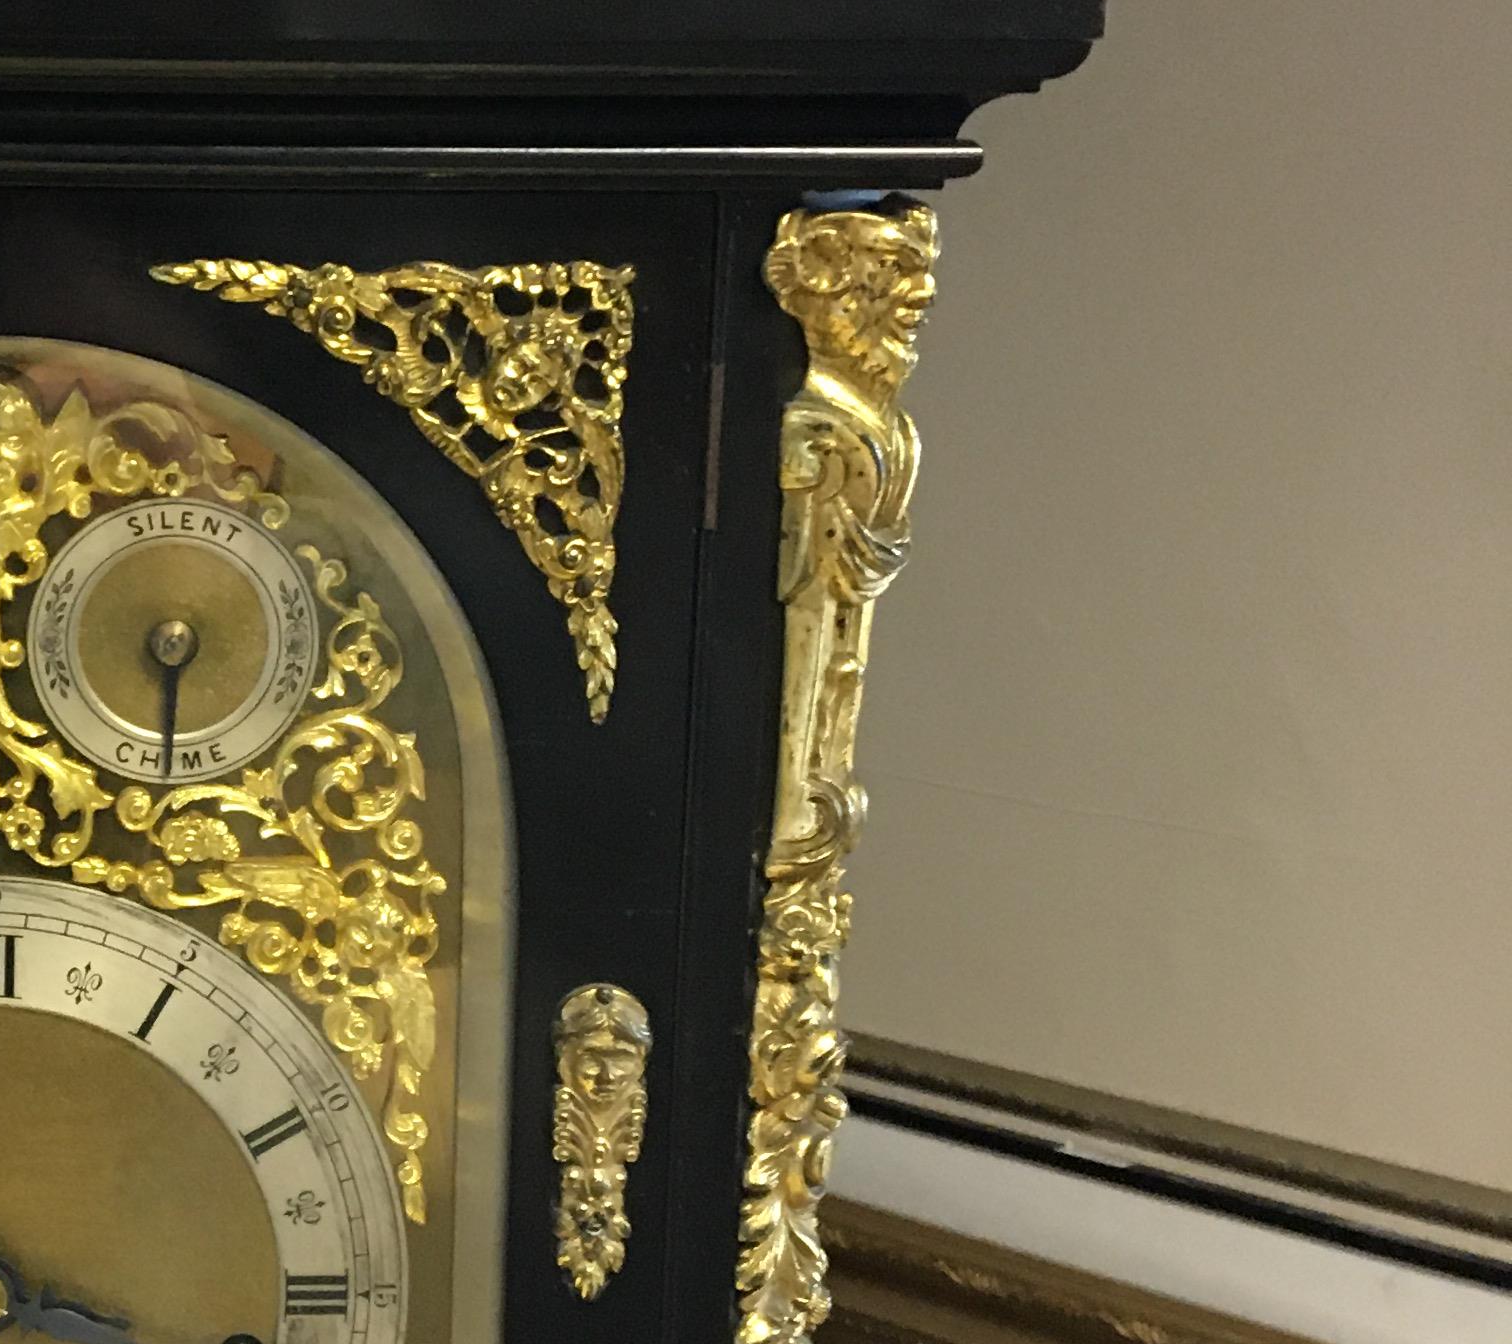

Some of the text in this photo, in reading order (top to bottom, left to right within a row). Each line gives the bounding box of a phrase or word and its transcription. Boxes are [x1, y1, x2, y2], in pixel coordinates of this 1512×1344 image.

[127, 512, 243, 543] SILENT
[116, 742, 226, 770] CHME
[180, 941, 202, 962] 5
[128, 977, 183, 1046] I
[320, 1081, 350, 1113] 10
[239, 1099, 311, 1164] II
[285, 1268, 349, 1322] III
[374, 1282, 398, 1309] 15
